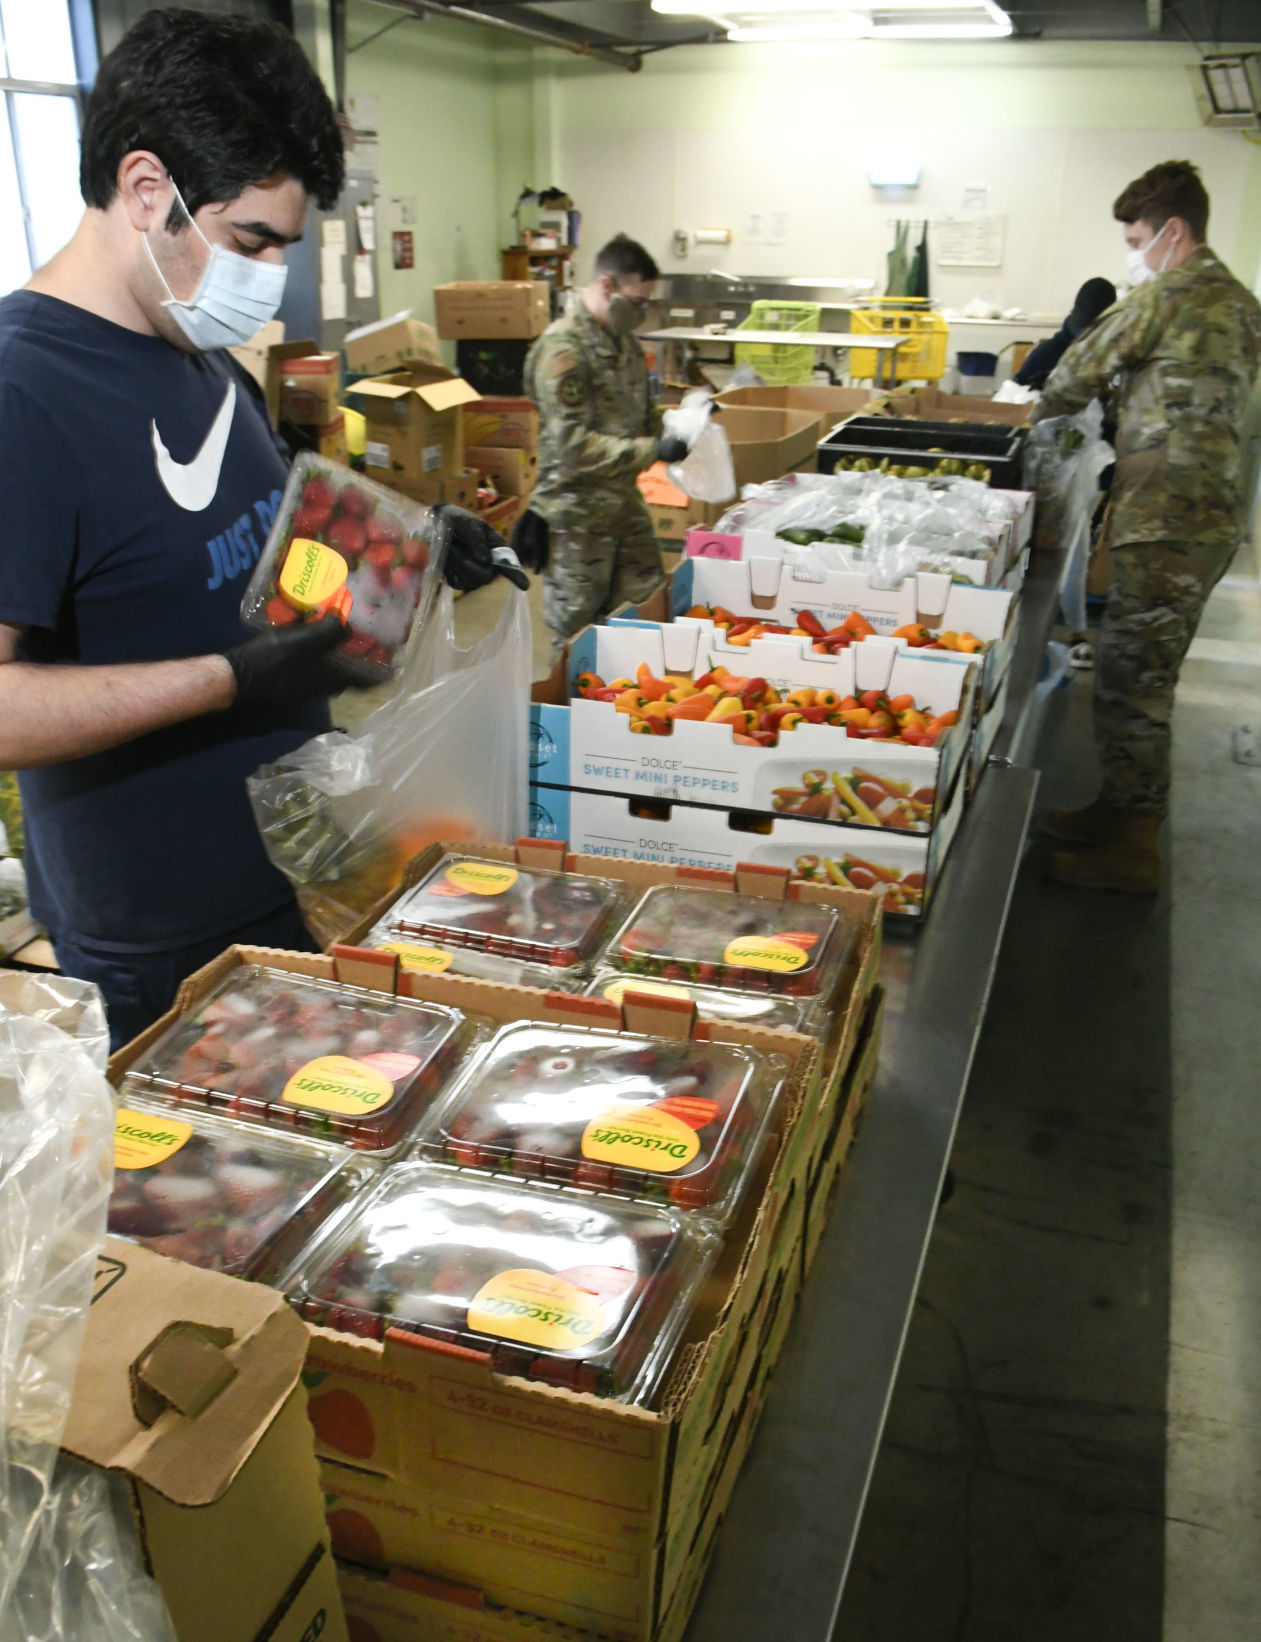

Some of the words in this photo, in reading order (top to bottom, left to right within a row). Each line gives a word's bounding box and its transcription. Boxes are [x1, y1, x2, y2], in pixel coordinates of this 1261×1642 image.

[207, 513, 261, 590] JUST
[584, 763, 629, 779] SWEET
[635, 770, 668, 785] MINI
[673, 775, 739, 793] PEPPERS
[583, 843, 629, 858] SWEET
[633, 850, 665, 864] MINI
[294, 1077, 382, 1104] Driscoll's
[588, 1128, 688, 1159] Driscoll's
[480, 1297, 595, 1337] Driscoll's
